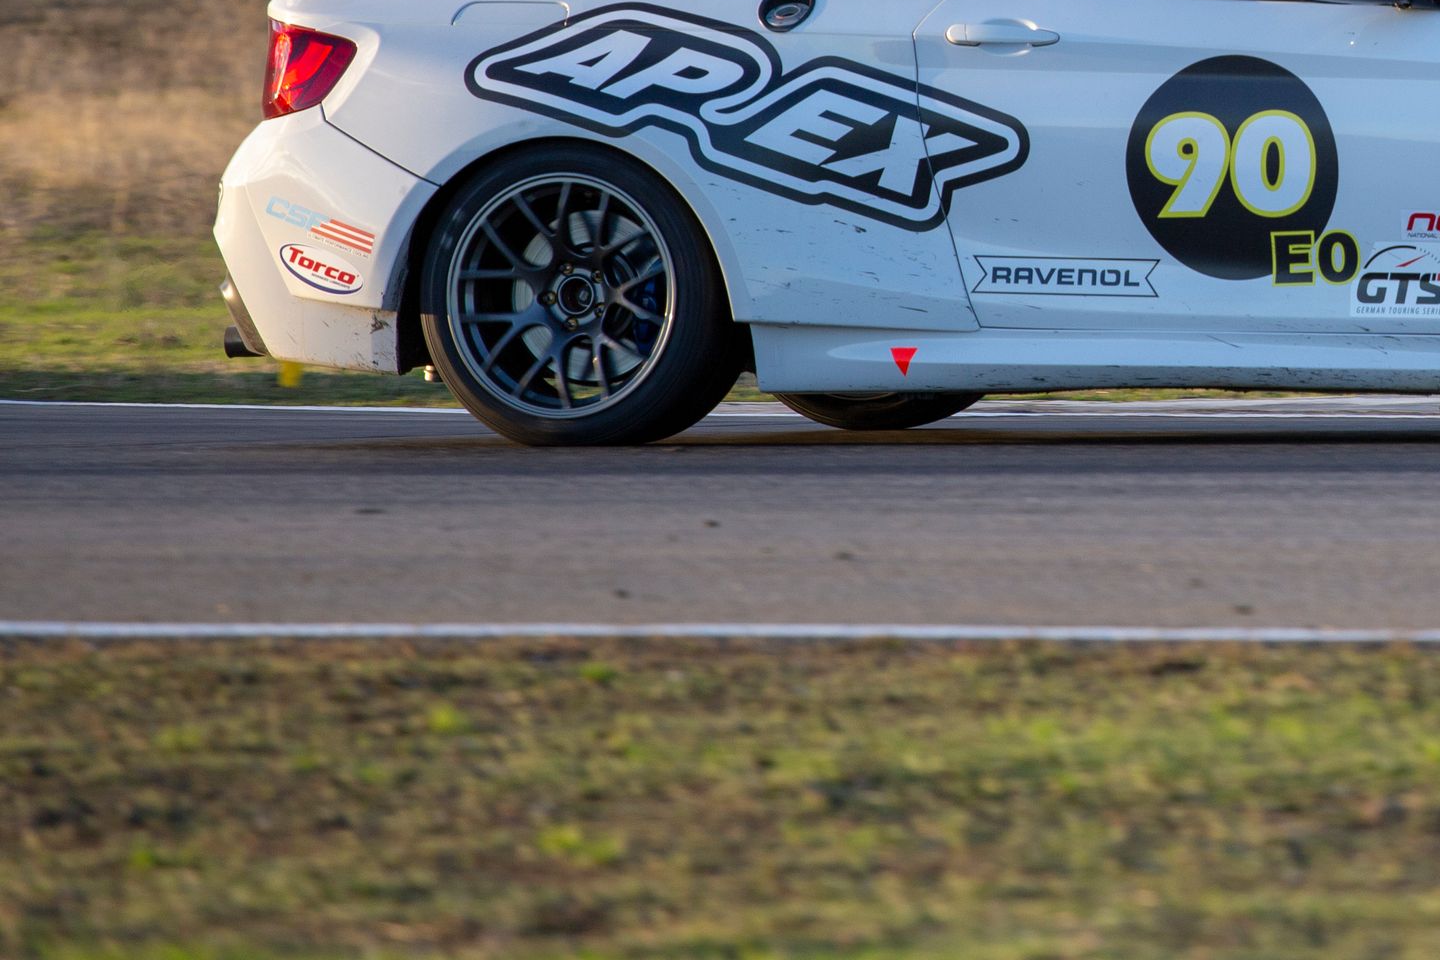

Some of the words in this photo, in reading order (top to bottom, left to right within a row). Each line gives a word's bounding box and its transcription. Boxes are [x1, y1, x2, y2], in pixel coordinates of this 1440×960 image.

[509, 25, 984, 200] APEX
[1144, 109, 1317, 219] 90
[265, 196, 330, 231] CSF
[1407, 231, 1438, 239] NATIONAL
[289, 246, 356, 285] Torco
[991, 266, 1140, 287] RAVENOL
[1356, 306, 1386, 314] GERMAN
[1388, 306, 1420, 315] TOURING
